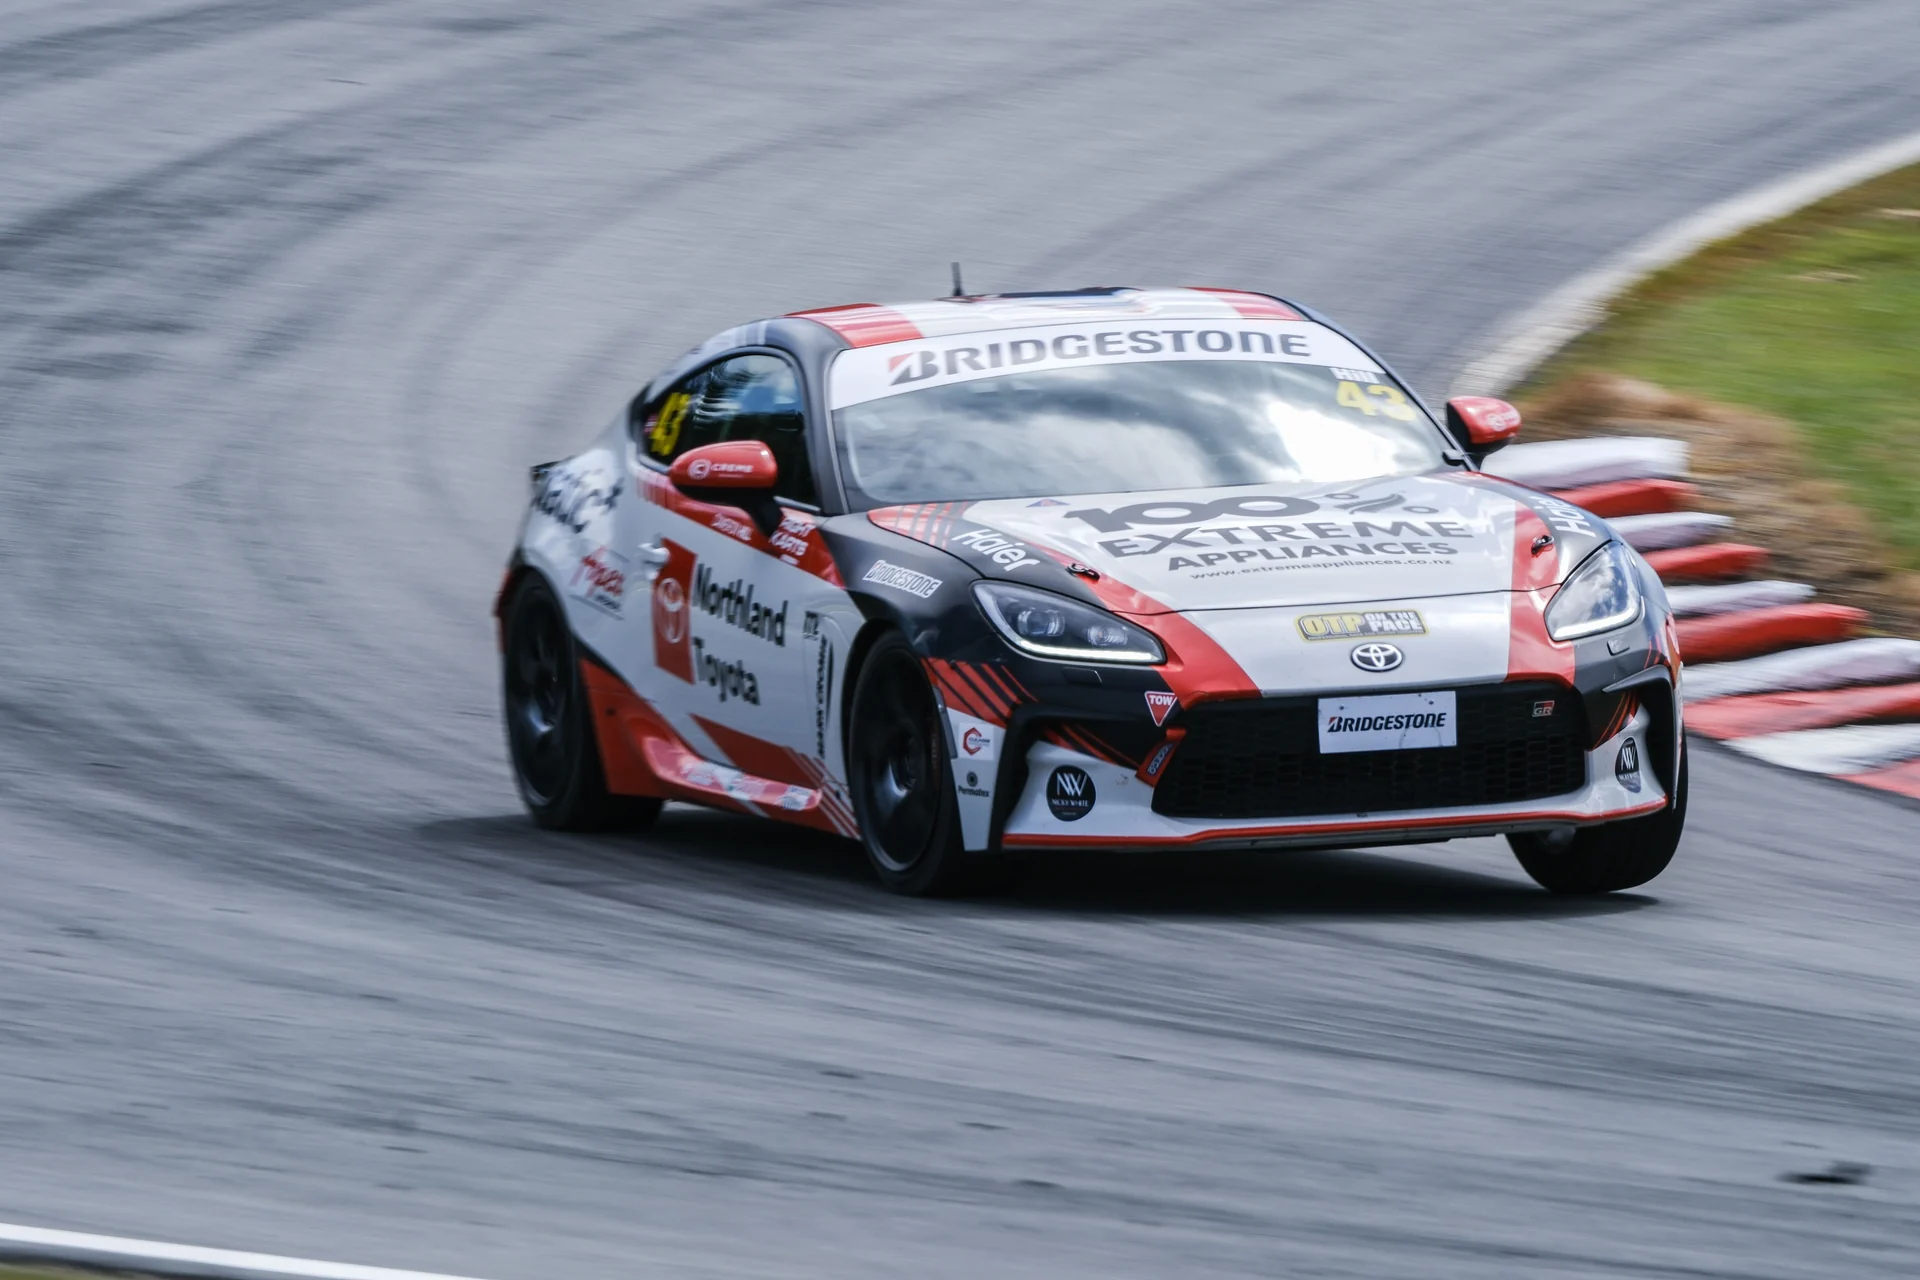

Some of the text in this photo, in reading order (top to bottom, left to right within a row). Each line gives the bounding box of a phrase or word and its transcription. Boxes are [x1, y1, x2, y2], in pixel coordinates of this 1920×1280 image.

[888, 329, 1311, 386] BRIDGESTONE
[1336, 381, 1417, 422] 43
[951, 529, 1040, 572] Haier
[1098, 520, 1474, 559] EXTREME
[1167, 541, 1458, 571] APPLIANCES
[1190, 558, 1454, 579] www.extremeappliances.co.nz
[866, 562, 940, 596] BRIDGESTONE
[691, 563, 788, 648] Northland
[1388, 611, 1417, 620] THE
[1300, 614, 1363, 636] OTP
[1370, 618, 1421, 631] PACE
[691, 636, 760, 706] Toyota
[1148, 695, 1173, 705] TOW
[1534, 707, 1551, 715] GR
[1327, 712, 1446, 733] BRIDGESTONE
[958, 785, 989, 797] Permatex
